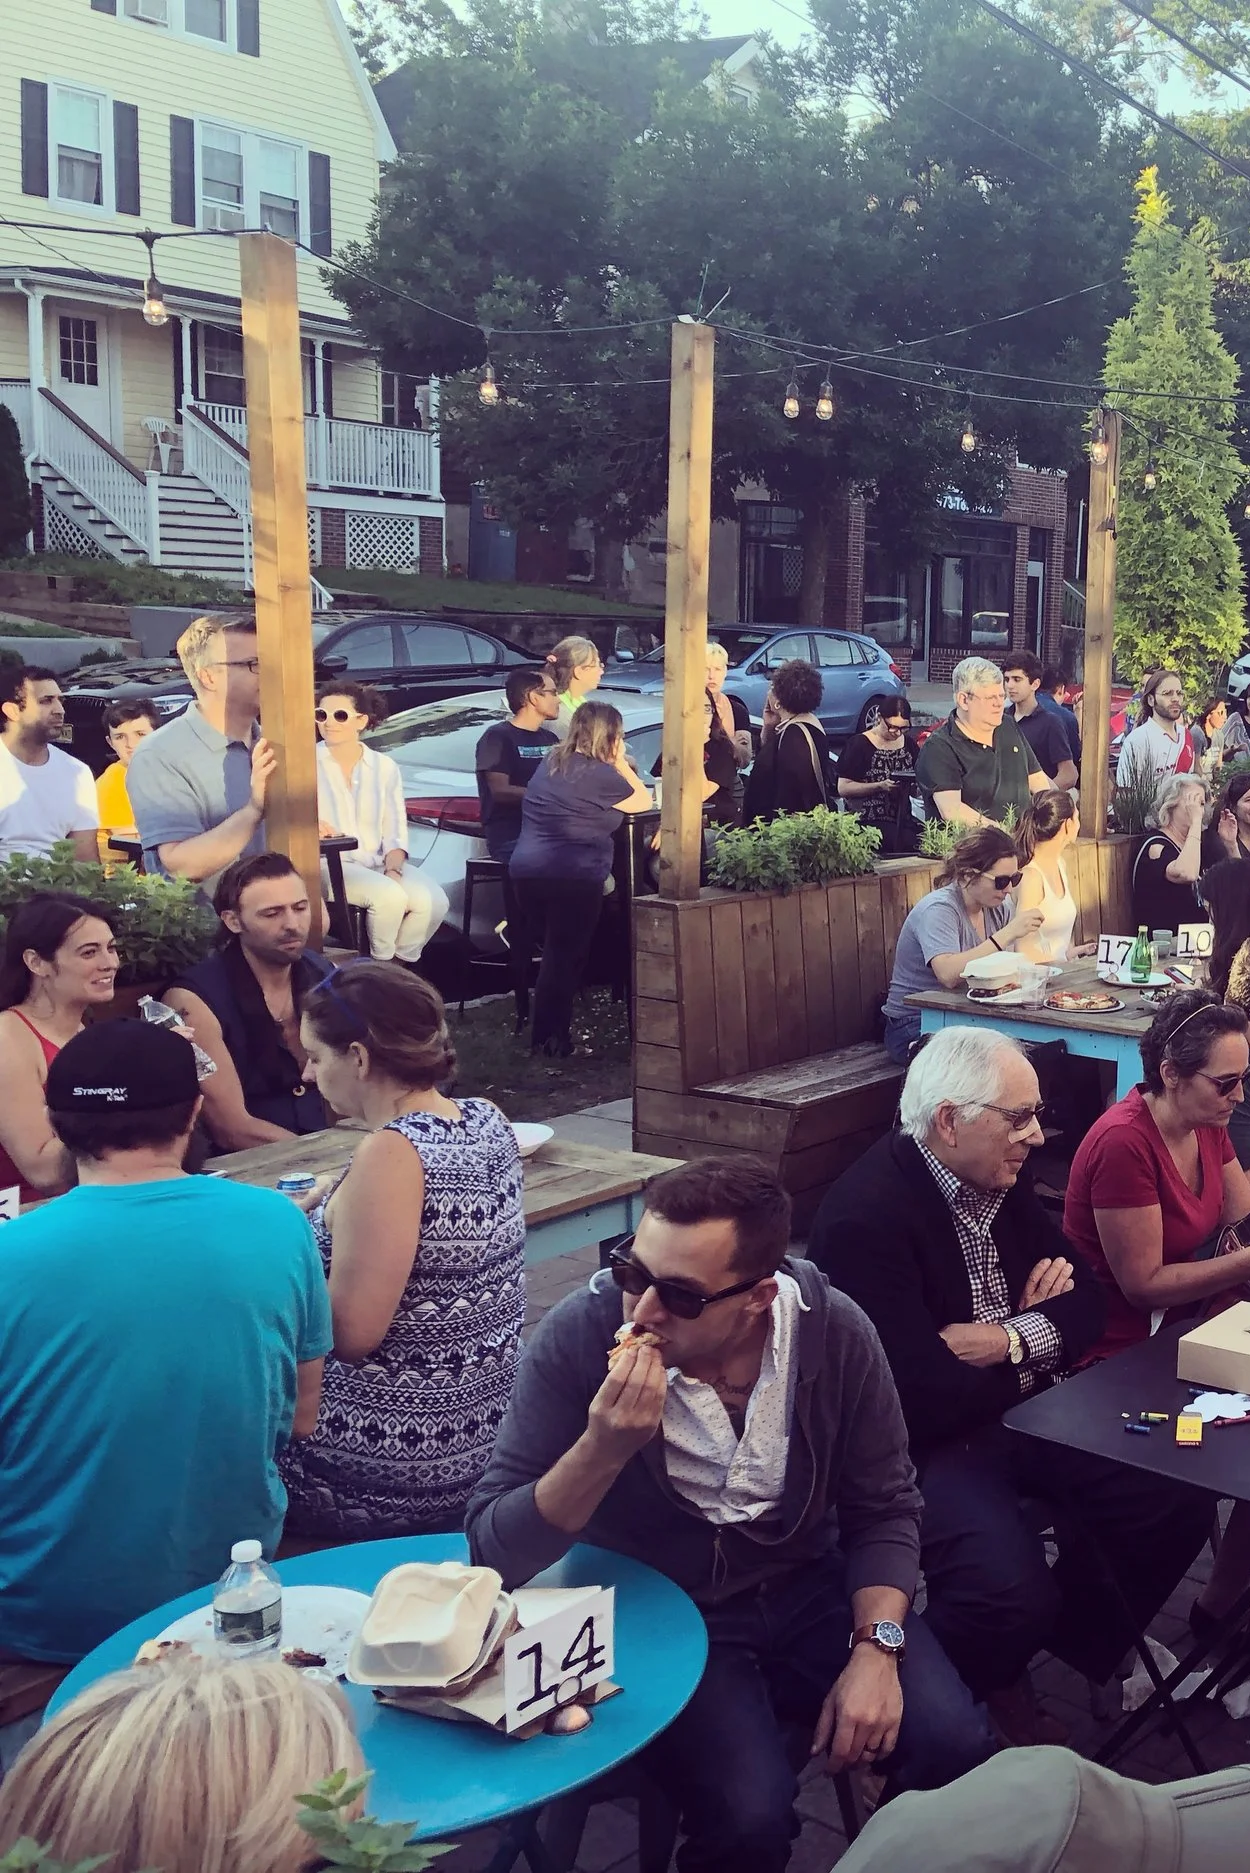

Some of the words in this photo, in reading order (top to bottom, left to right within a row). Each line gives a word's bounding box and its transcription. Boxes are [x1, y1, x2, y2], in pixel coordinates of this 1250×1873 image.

[1098, 939, 1133, 966] 17
[1179, 930, 1211, 954] 10
[516, 1615, 606, 1712] 14
